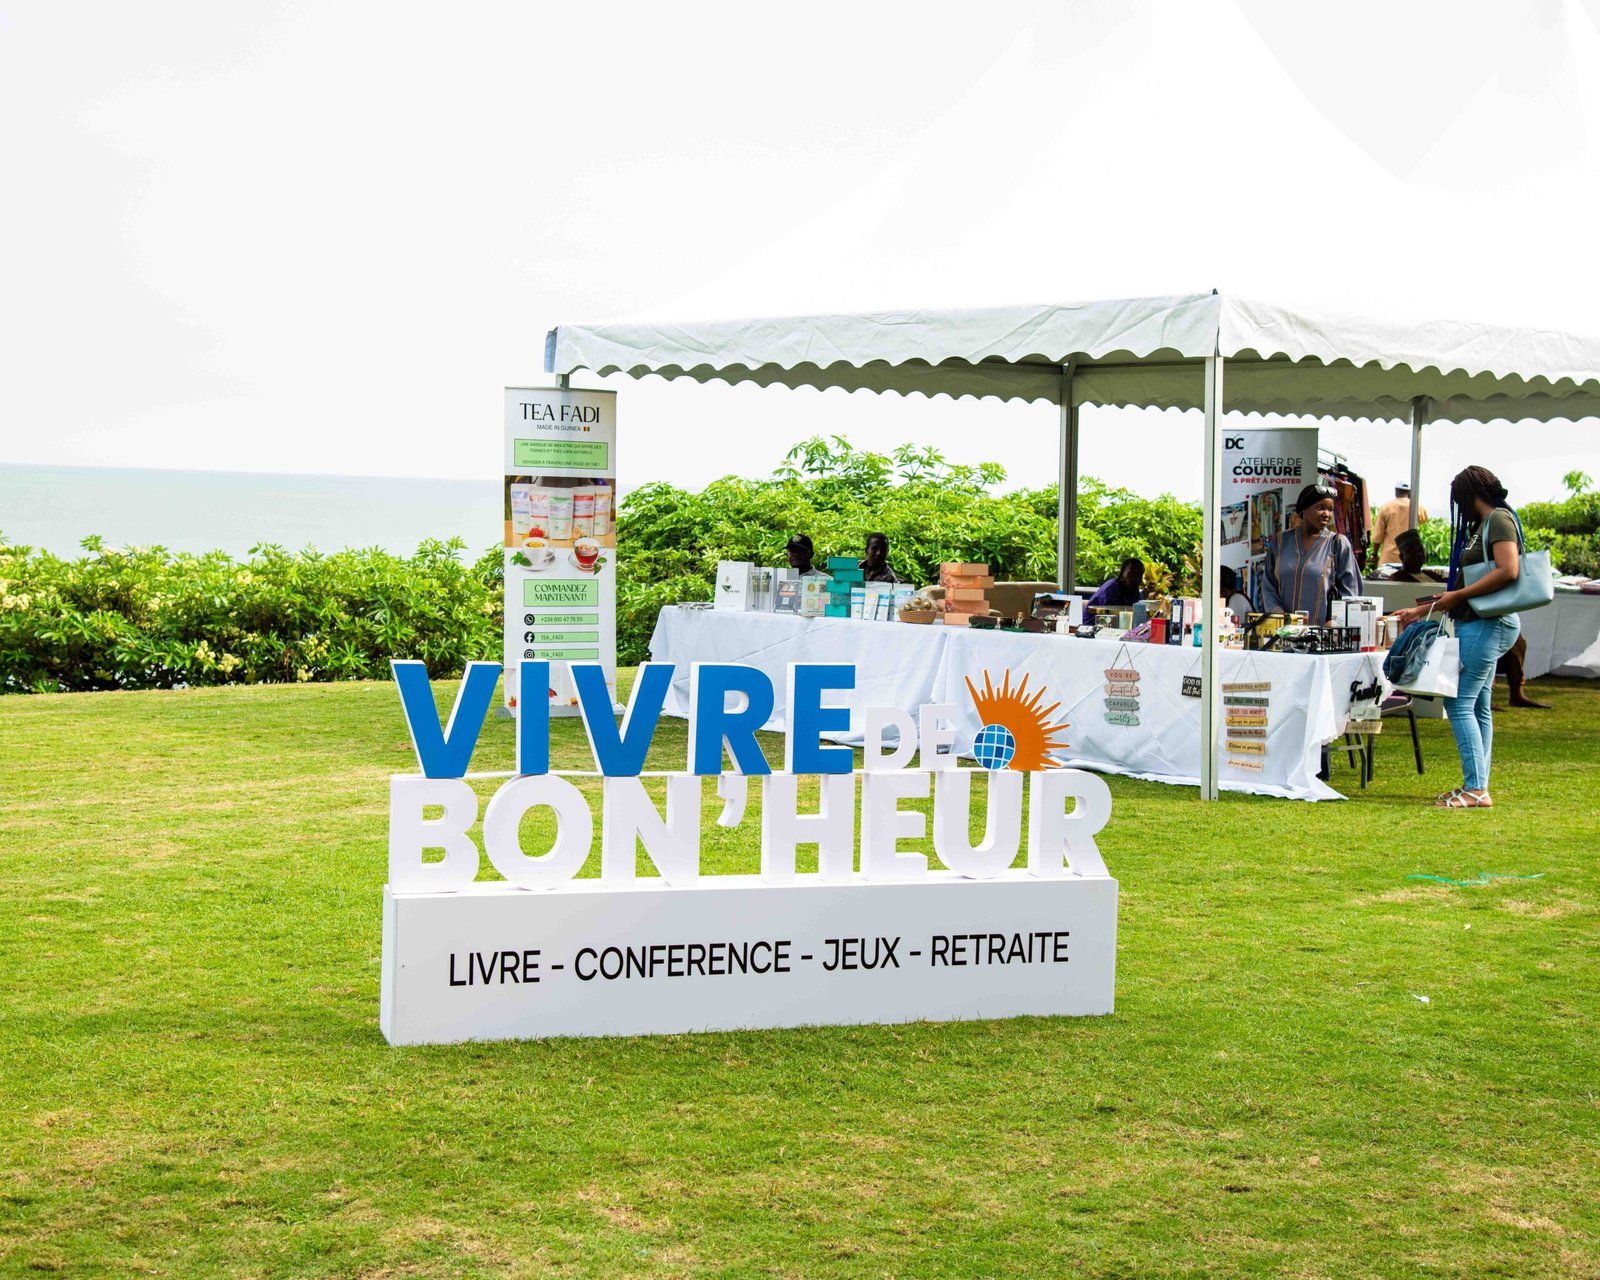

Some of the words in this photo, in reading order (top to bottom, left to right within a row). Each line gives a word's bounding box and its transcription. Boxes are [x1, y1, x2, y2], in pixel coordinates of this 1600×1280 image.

[520, 403, 555, 421] TEA
[561, 405, 600, 423] FADI
[1233, 466, 1302, 476] COUTURE
[1239, 457, 1284, 466] ATELIER
[1287, 458, 1302, 466] DE
[534, 584, 587, 592] COMMANDEZ
[1109, 700, 1133, 708] CAPABLE
[391, 659, 856, 777] VIVRE
[865, 702, 959, 771] DE
[389, 768, 1112, 893] BON'HEUR
[449, 949, 541, 987] LIVRE
[574, 940, 792, 982] CONFERENCE
[822, 936, 901, 972] JEUX
[931, 931, 1070, 967] RETRAITE
